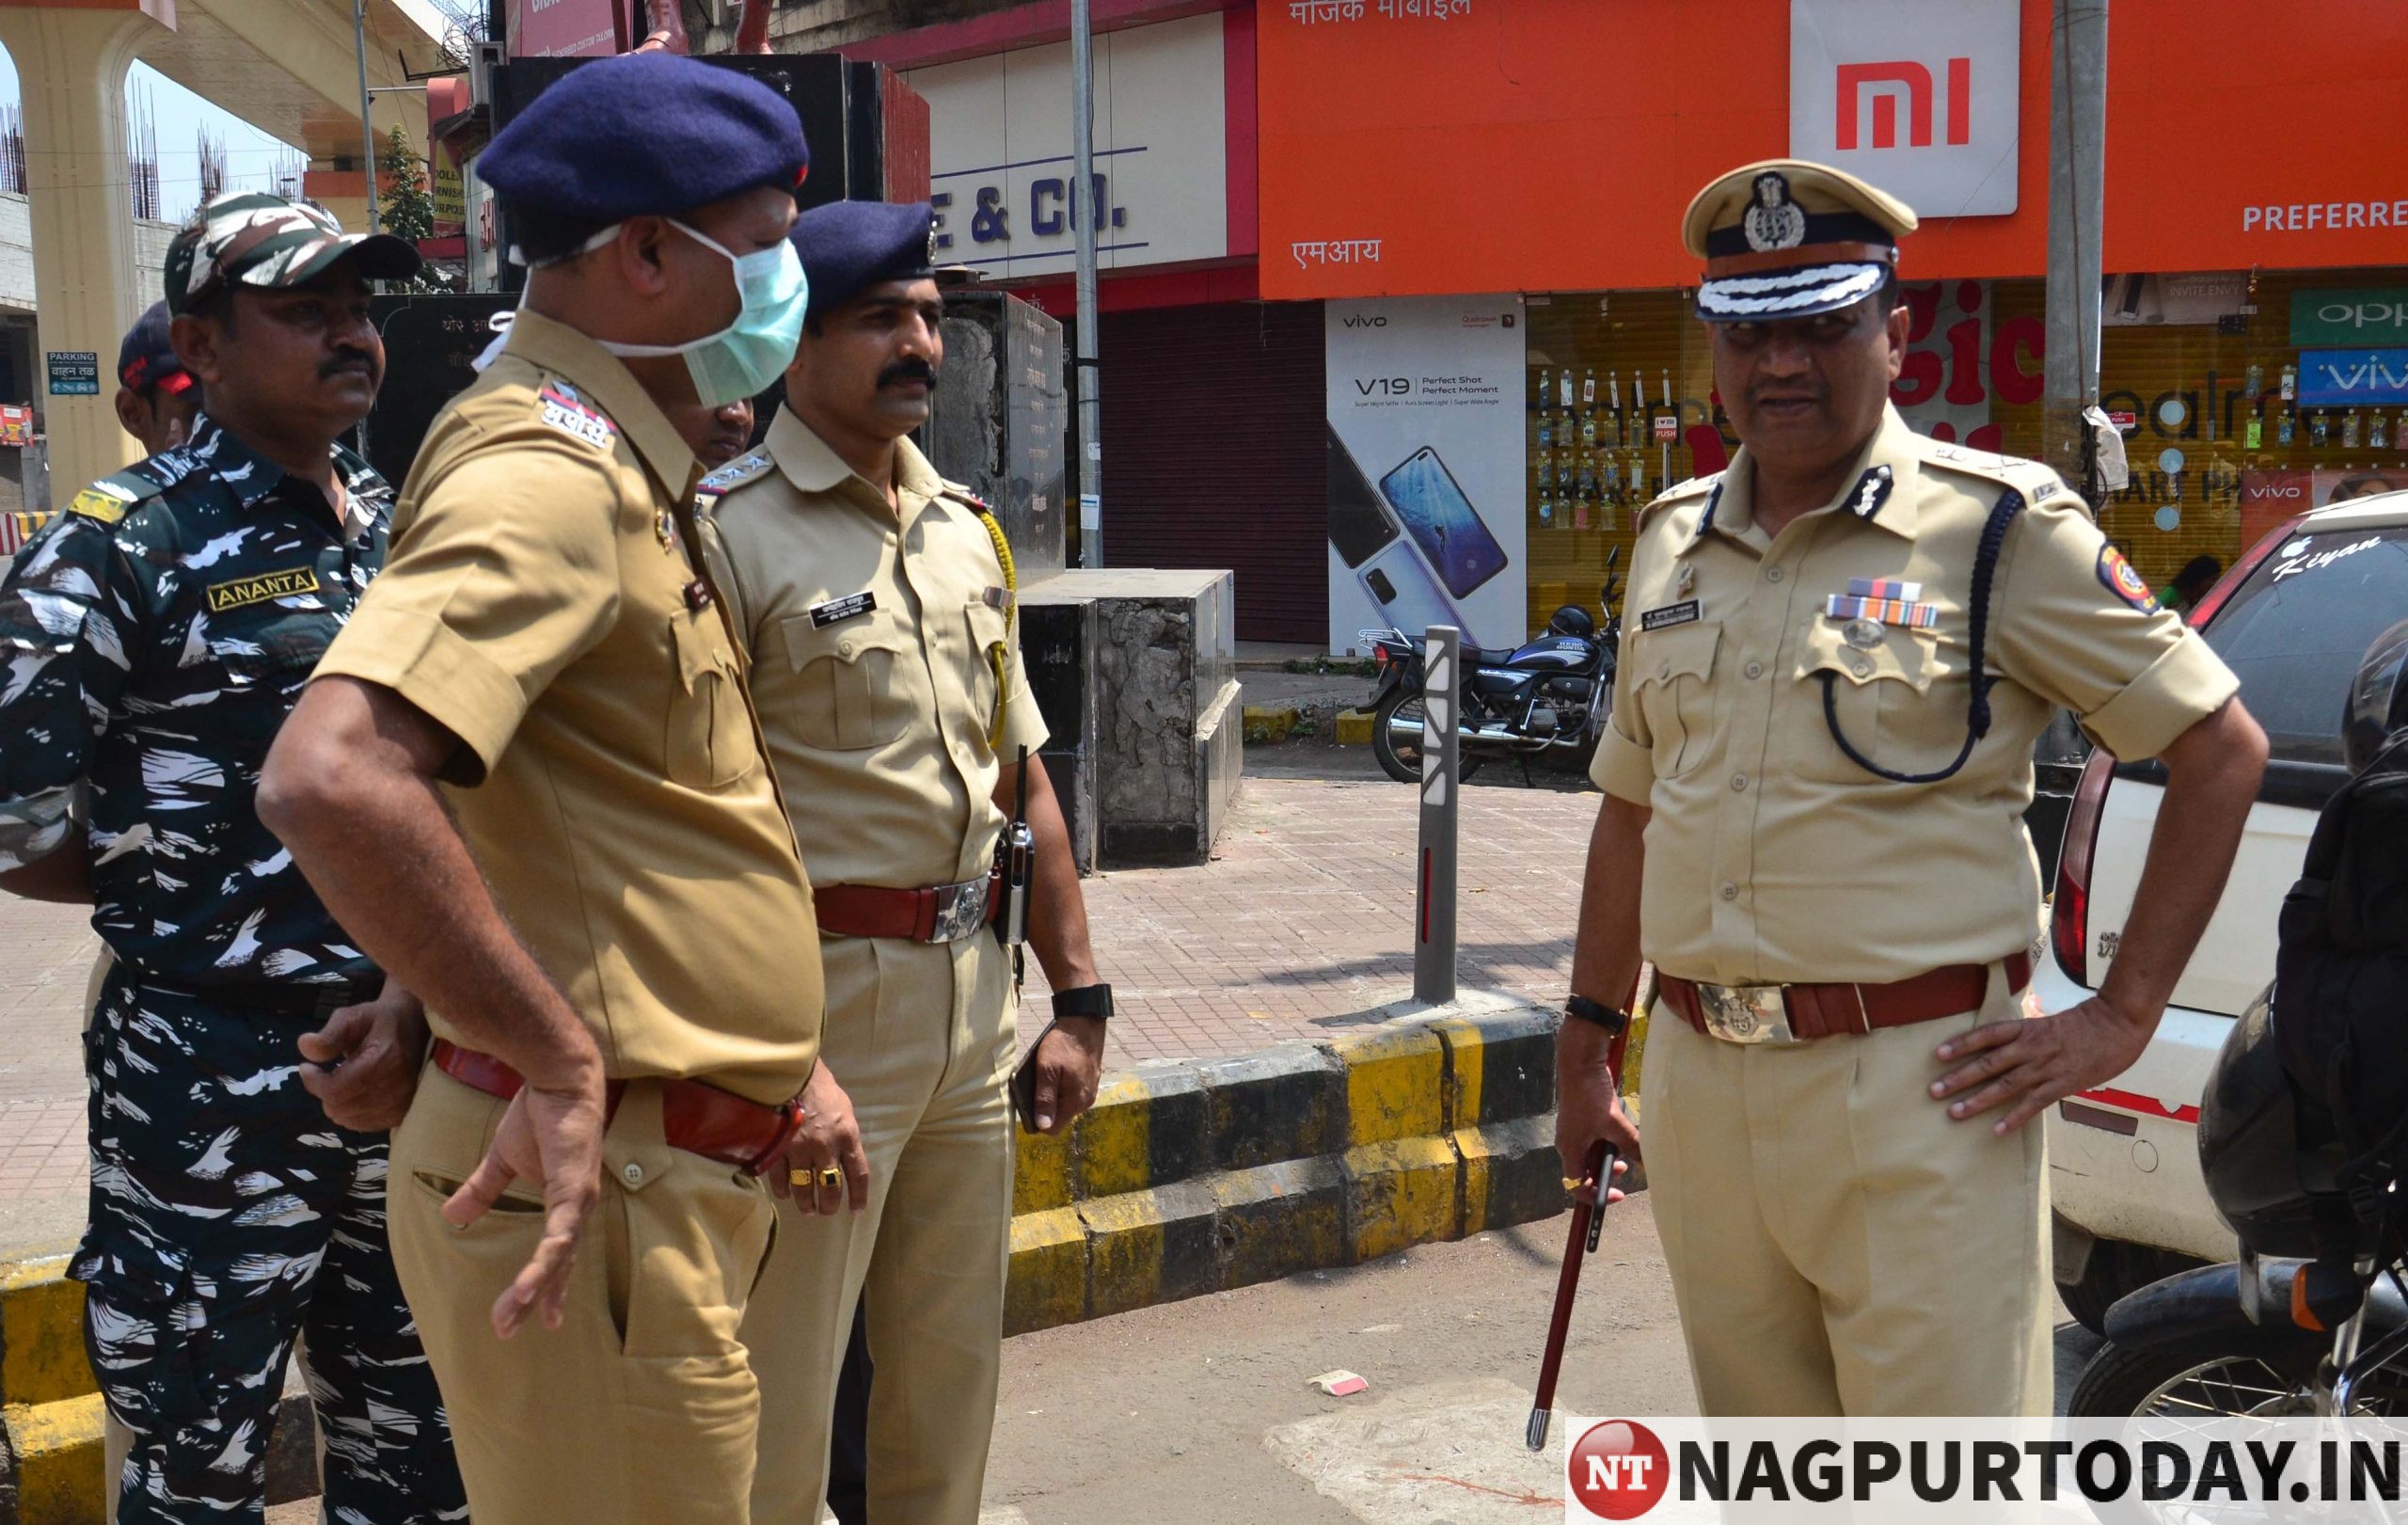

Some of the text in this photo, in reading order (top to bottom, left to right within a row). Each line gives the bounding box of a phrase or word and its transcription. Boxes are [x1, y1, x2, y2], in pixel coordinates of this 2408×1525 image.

[972, 186, 1012, 243] &
[2242, 200, 2408, 232] PREFERRE
[1291, 239, 1382, 270] एमआय
[2168, 284, 2240, 296] INVITE ENVY
[1343, 314, 1387, 328] vivo
[51, 367, 75, 376] वाहन
[1354, 377, 1410, 396] V19
[1459, 386, 1498, 394] Moment
[1656, 430, 1677, 438] PUSH
[2250, 485, 2301, 498] vivo
[217, 573, 309, 607] ANANTA
